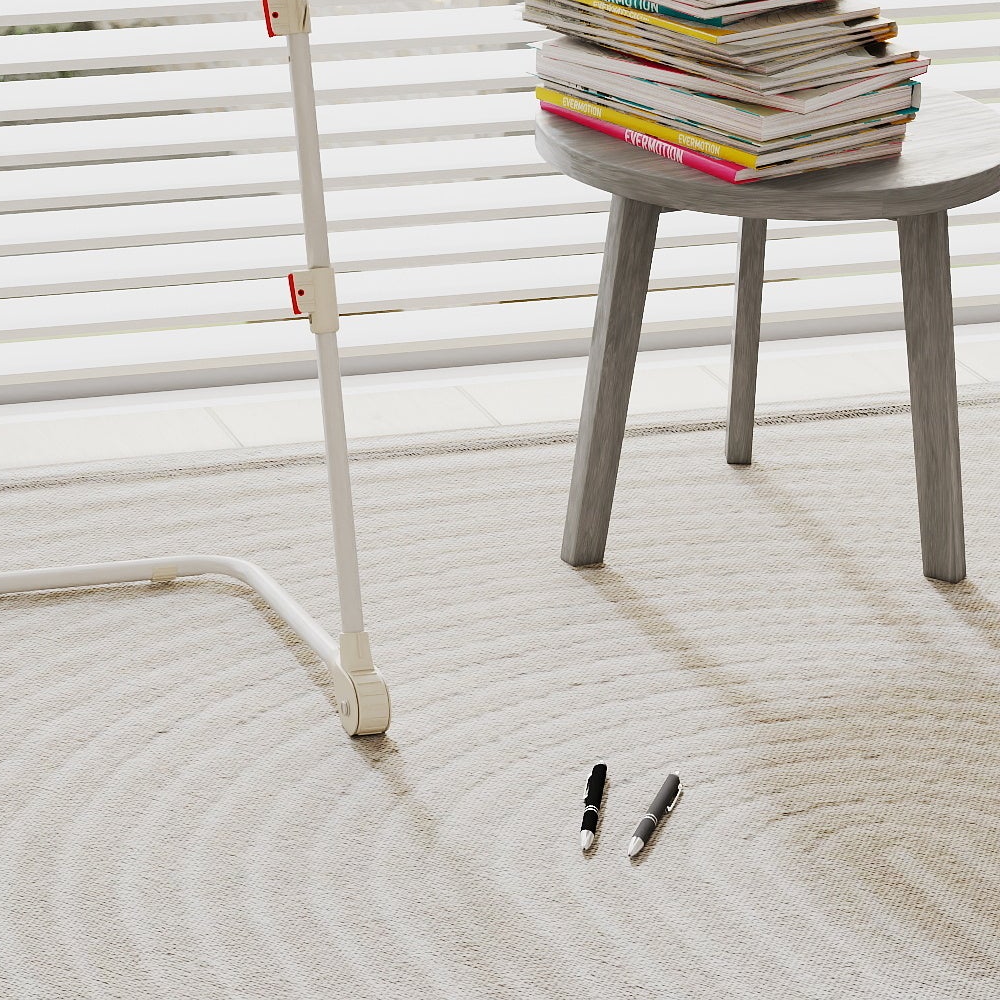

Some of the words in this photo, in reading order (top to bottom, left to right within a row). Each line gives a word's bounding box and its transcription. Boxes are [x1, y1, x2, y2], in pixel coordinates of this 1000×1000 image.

[562, 97, 603, 118] EVERMOTION
[624, 129, 684, 164] EVERMOTION
[678, 134, 720, 156] EVERMOTION
